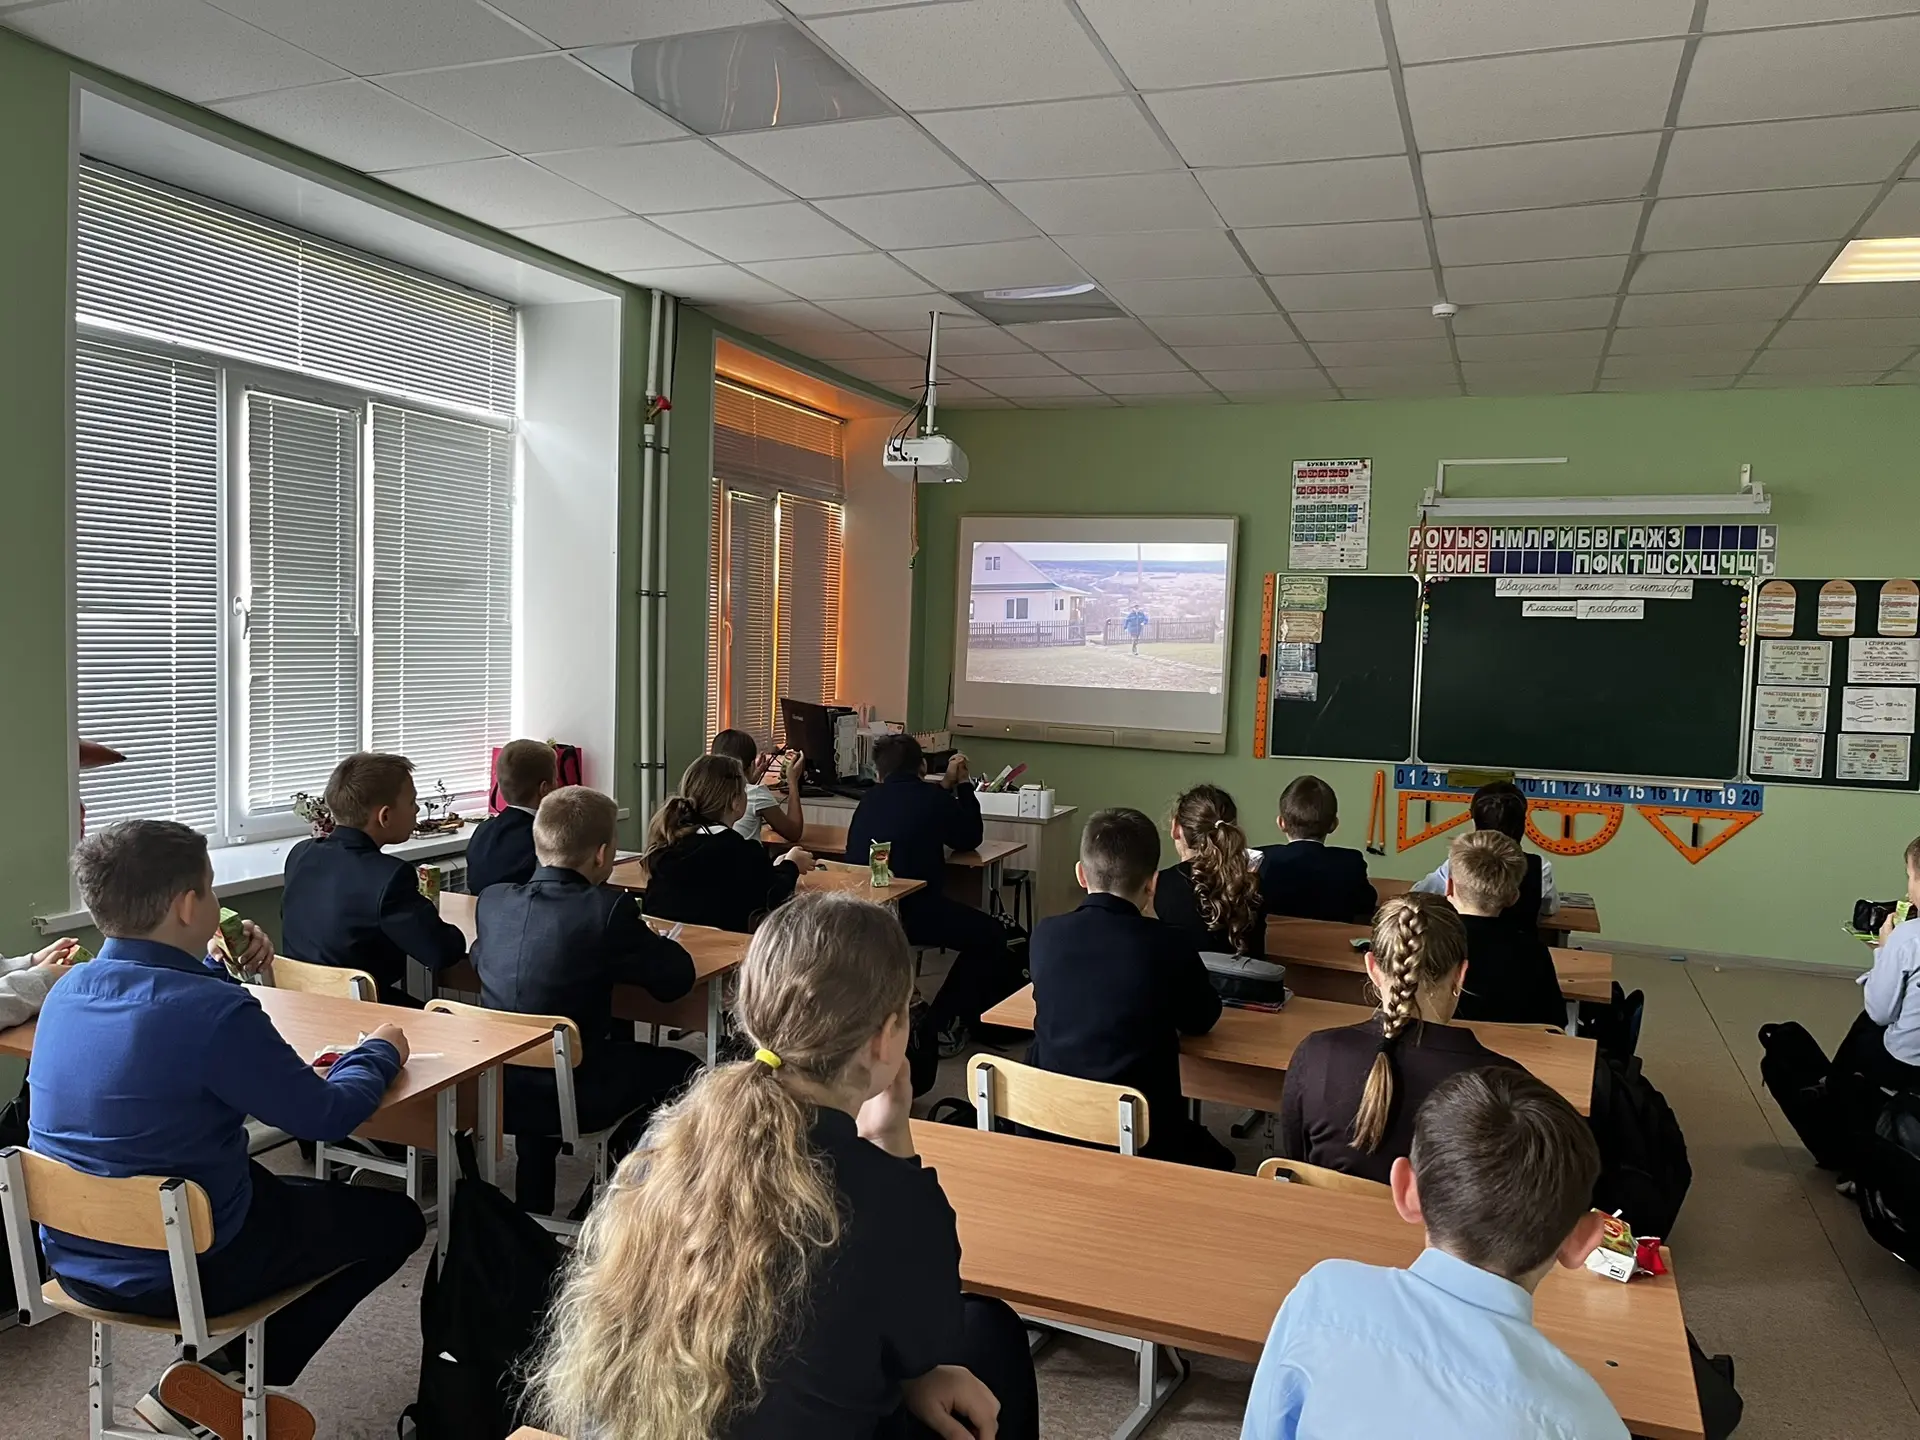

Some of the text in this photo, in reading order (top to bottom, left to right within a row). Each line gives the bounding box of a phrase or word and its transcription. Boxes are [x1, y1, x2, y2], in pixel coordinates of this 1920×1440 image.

[1497, 579, 1690, 597] Двадцать пятое сентября
[1526, 599, 1638, 617] Классная работа
[1397, 769, 1759, 806] 0 1 2 3 10 11 12 13 14 15 16 17 18 19 20
